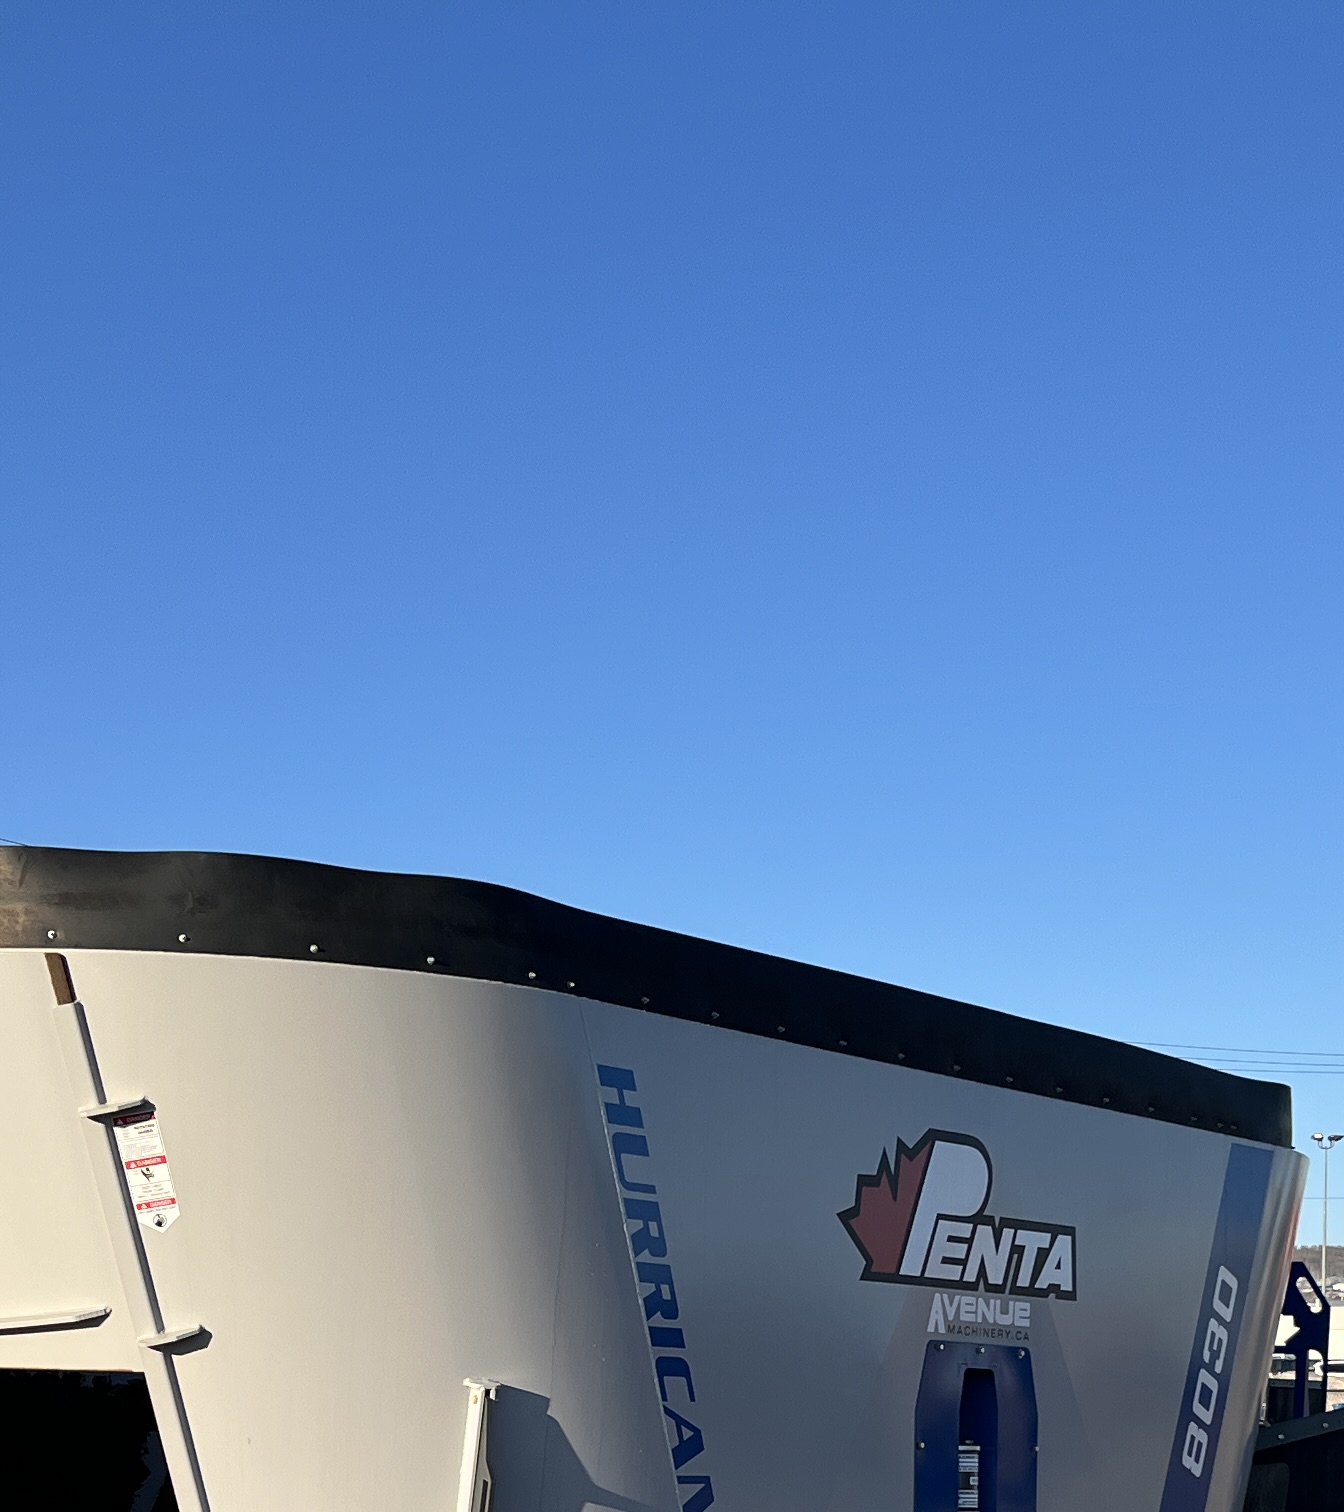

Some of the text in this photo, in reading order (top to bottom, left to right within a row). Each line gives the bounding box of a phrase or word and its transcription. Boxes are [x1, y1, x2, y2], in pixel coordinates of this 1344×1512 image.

[899, 1139, 1073, 1292] PENTA
[926, 1292, 1031, 1334] AVENUE
[946, 1323, 1031, 1342] MACHINERY.CA
[1181, 1265, 1239, 1478] 8030
